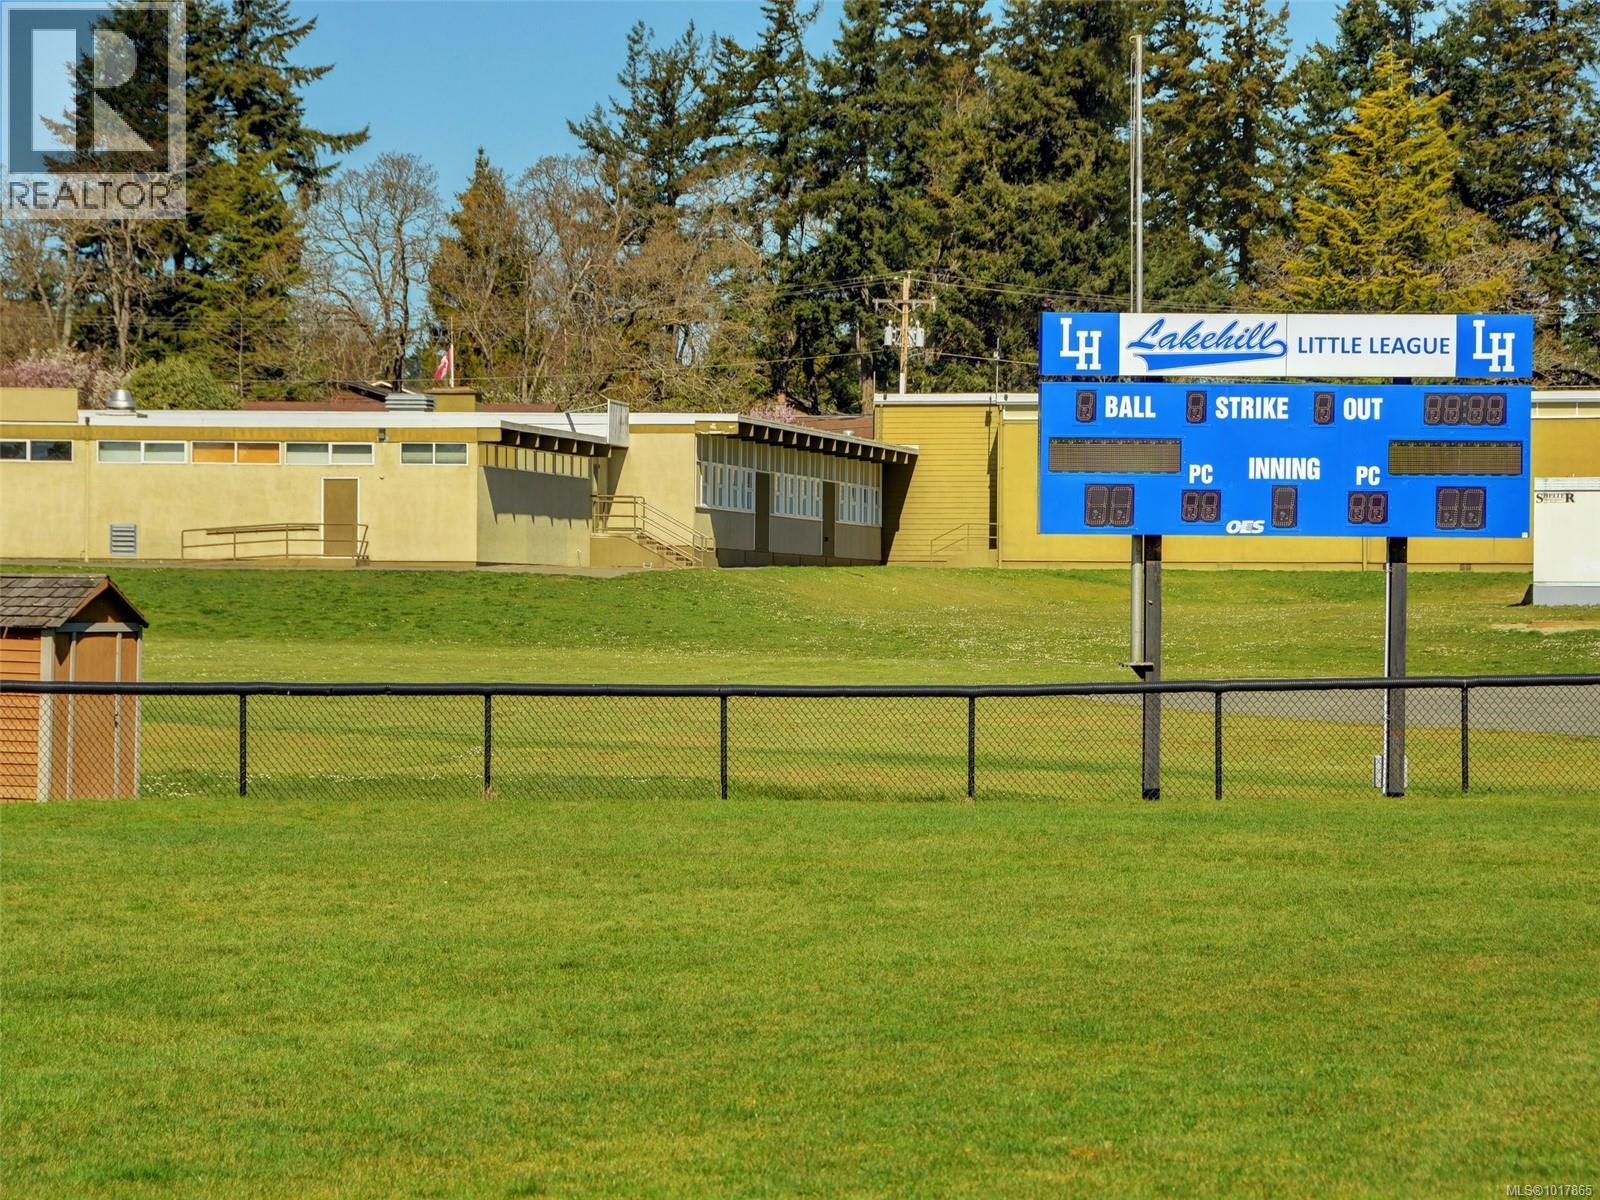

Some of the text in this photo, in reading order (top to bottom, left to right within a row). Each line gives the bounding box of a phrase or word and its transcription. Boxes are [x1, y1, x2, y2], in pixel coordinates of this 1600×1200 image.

[1060, 317, 1101, 371] LH
[1126, 316, 1287, 357] Lakehill
[1298, 336, 1450, 355] LITTLE LEAGUE
[1473, 319, 1515, 372] LH
[1105, 395, 1384, 421] BALL STRIKE OUT
[1189, 457, 1381, 487] PC INNING PC
[1226, 520, 1265, 534] OES
